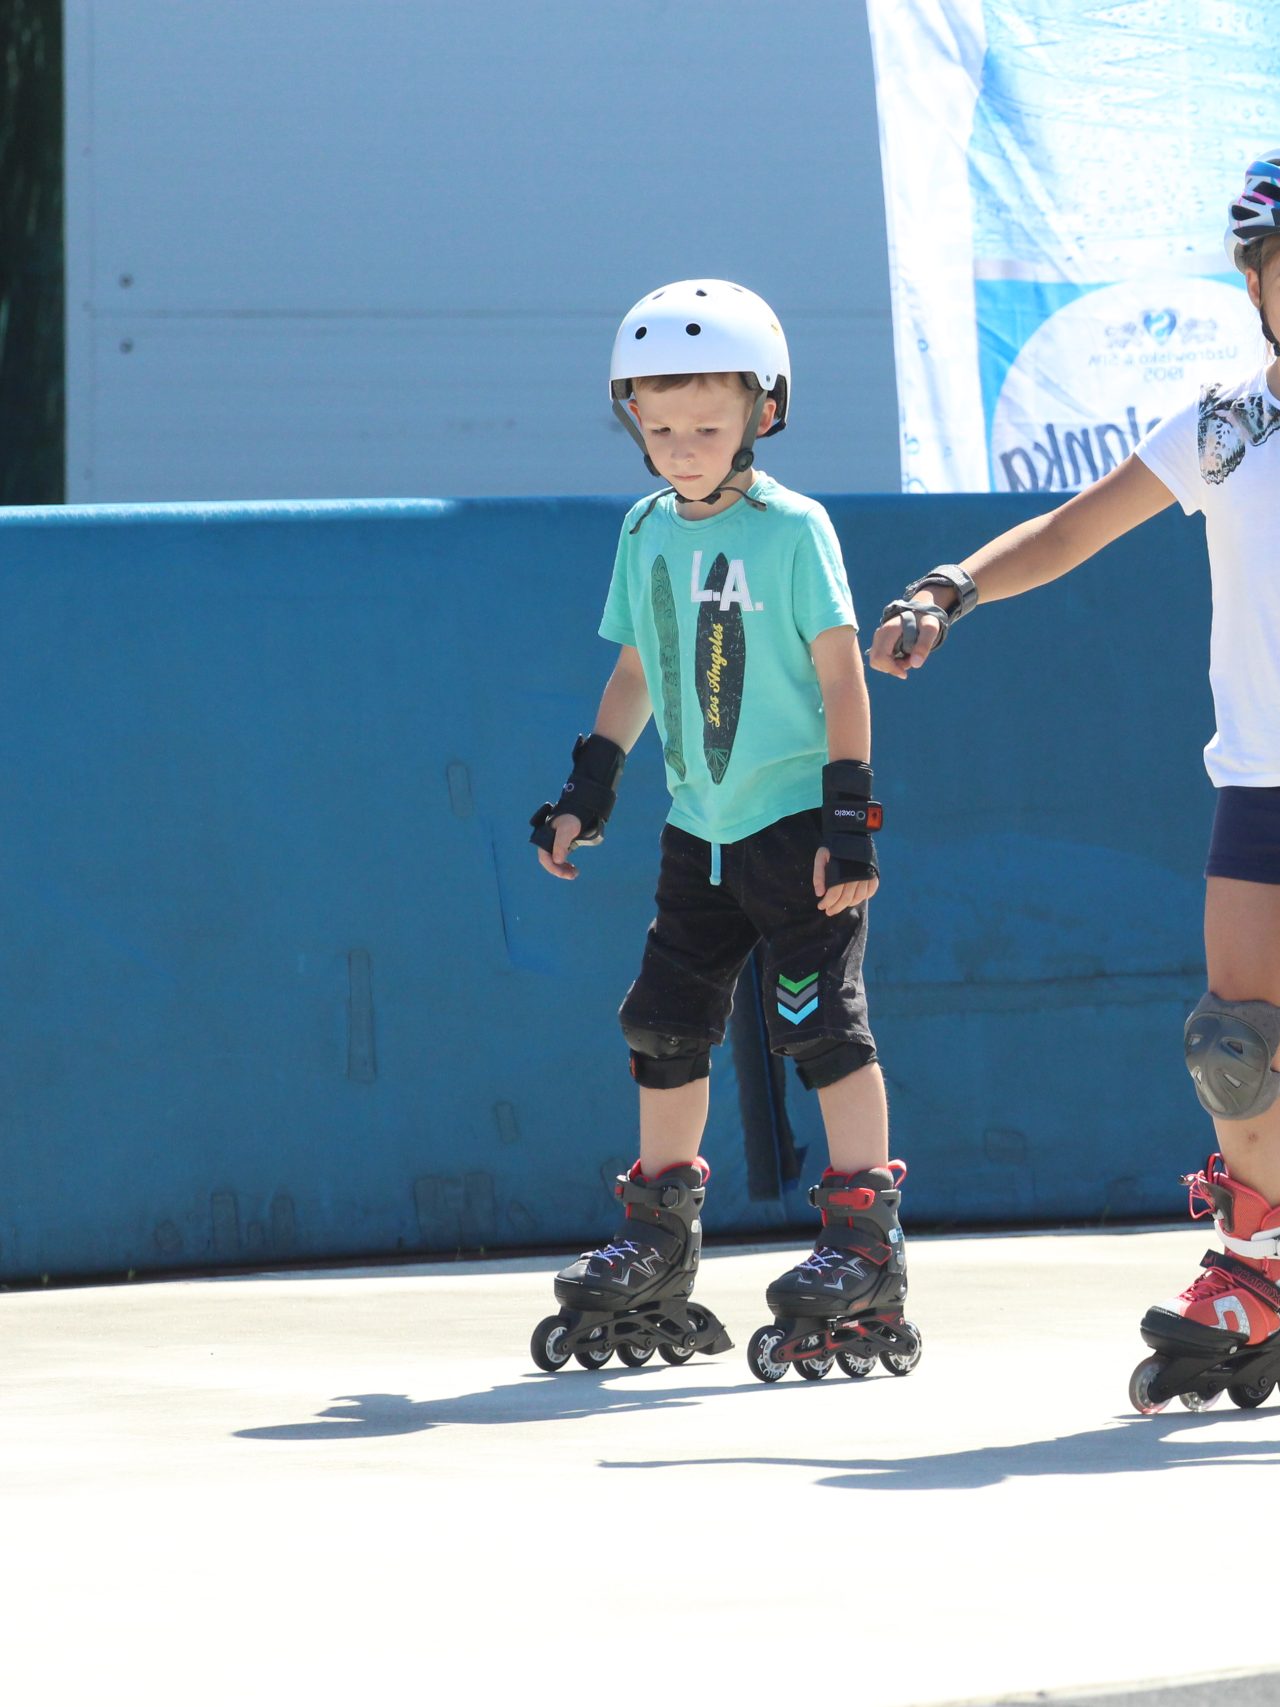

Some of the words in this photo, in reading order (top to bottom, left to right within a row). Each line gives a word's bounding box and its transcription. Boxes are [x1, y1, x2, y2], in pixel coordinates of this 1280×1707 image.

[691, 550, 764, 612] L.A.
[706, 623, 727, 694] Angeles
[707, 695, 723, 728] Los
[834, 809, 856, 817] oxelo
